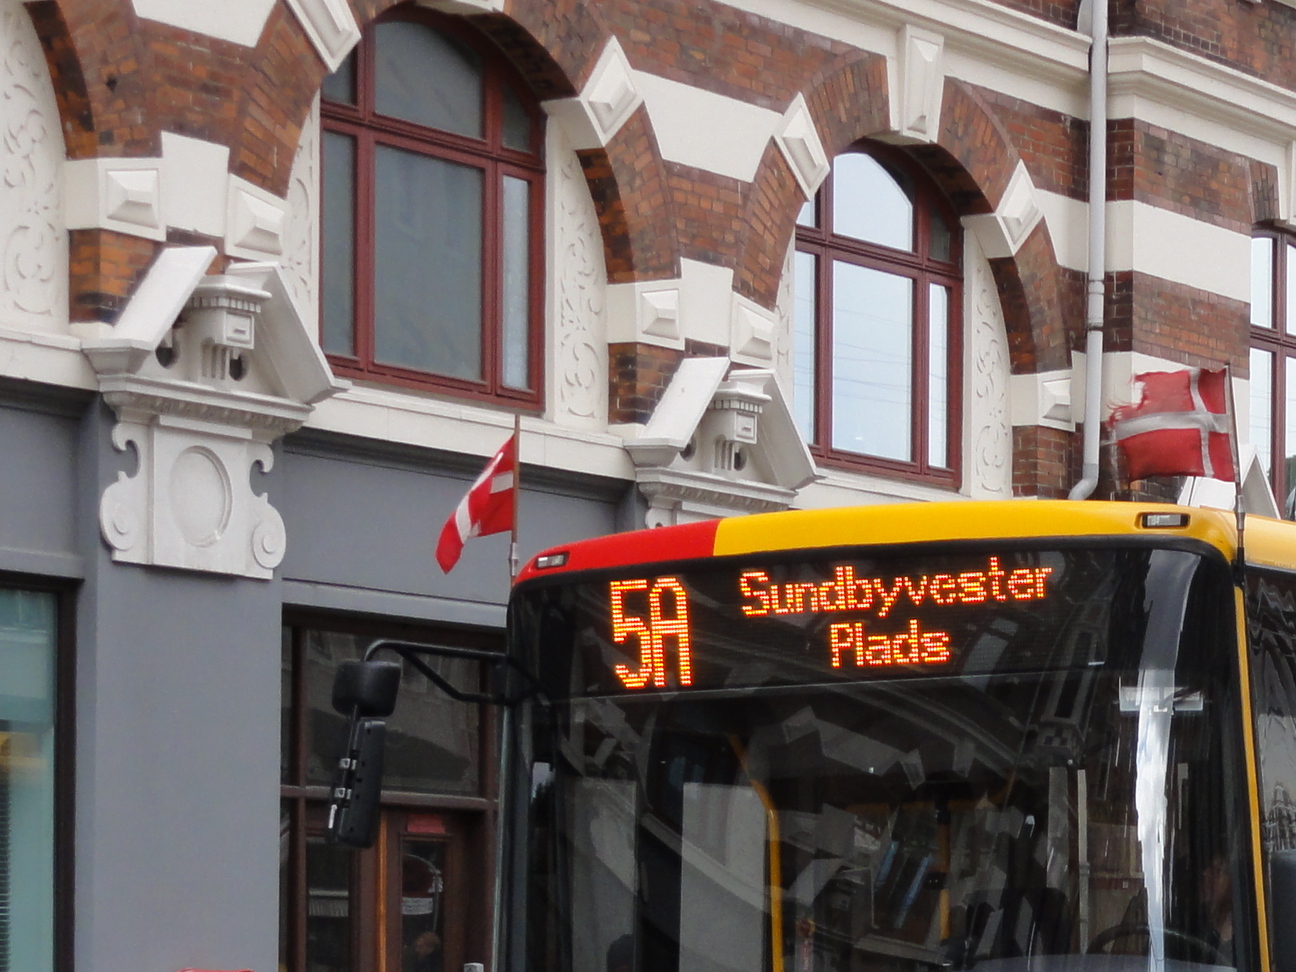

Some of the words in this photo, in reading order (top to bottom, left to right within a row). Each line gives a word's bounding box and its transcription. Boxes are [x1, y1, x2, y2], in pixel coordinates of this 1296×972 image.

[740, 556, 1053, 617] Sundbyvester
[610, 576, 692, 688] 5A
[829, 618, 949, 667] Plads
